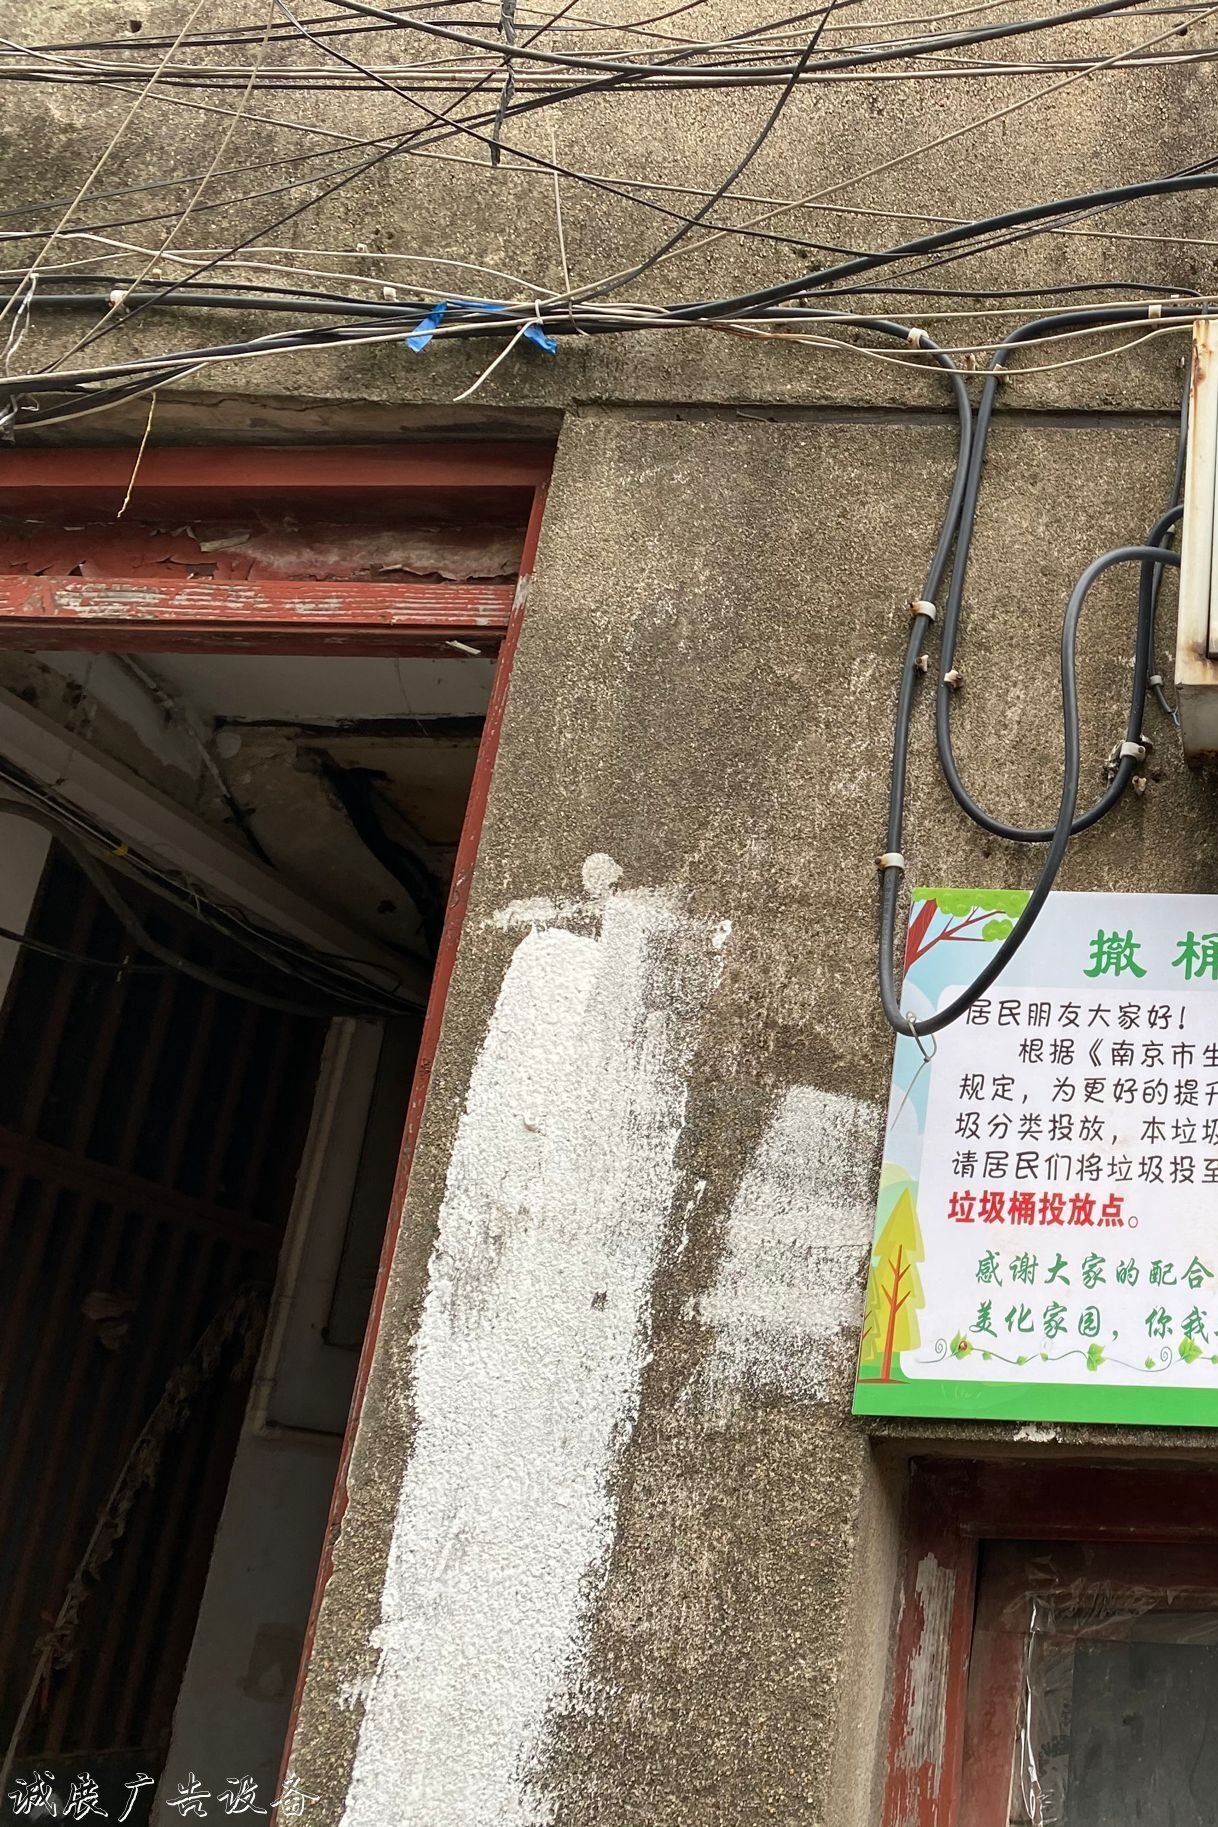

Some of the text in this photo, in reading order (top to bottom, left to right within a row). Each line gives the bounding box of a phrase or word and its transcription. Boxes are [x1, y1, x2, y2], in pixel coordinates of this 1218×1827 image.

[946, 1190, 1140, 1230] 垃圾桶投放点。
